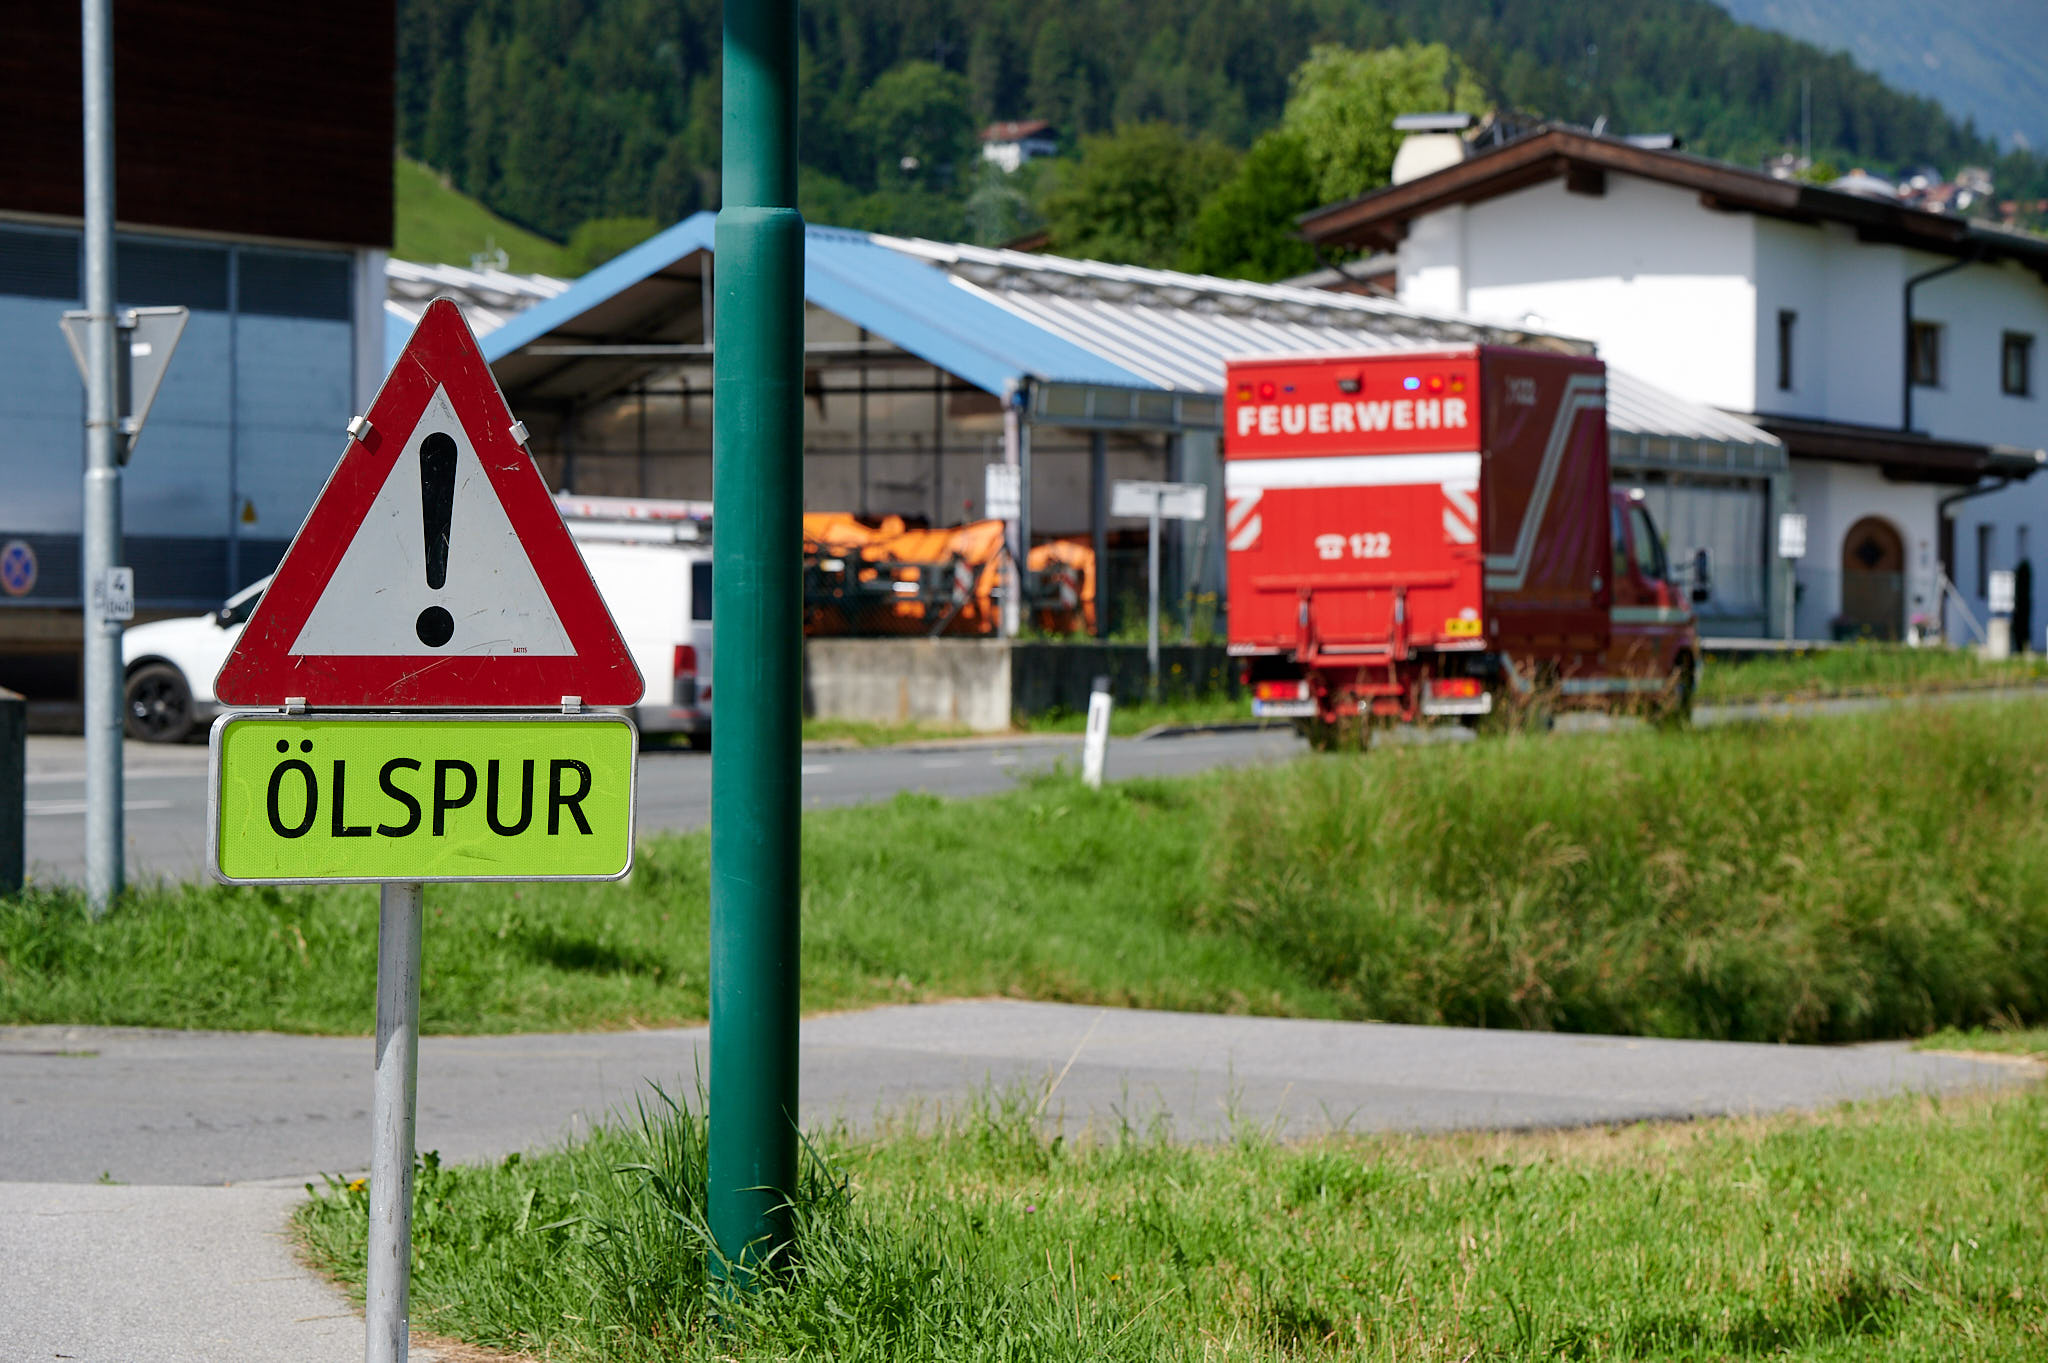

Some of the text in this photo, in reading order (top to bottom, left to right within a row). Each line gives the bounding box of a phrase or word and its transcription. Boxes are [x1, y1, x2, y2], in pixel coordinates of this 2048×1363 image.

[1237, 398, 1467, 436] FEUERWEHR
[1350, 532, 1391, 559] 122
[267, 739, 593, 839] ÖLSPUR
